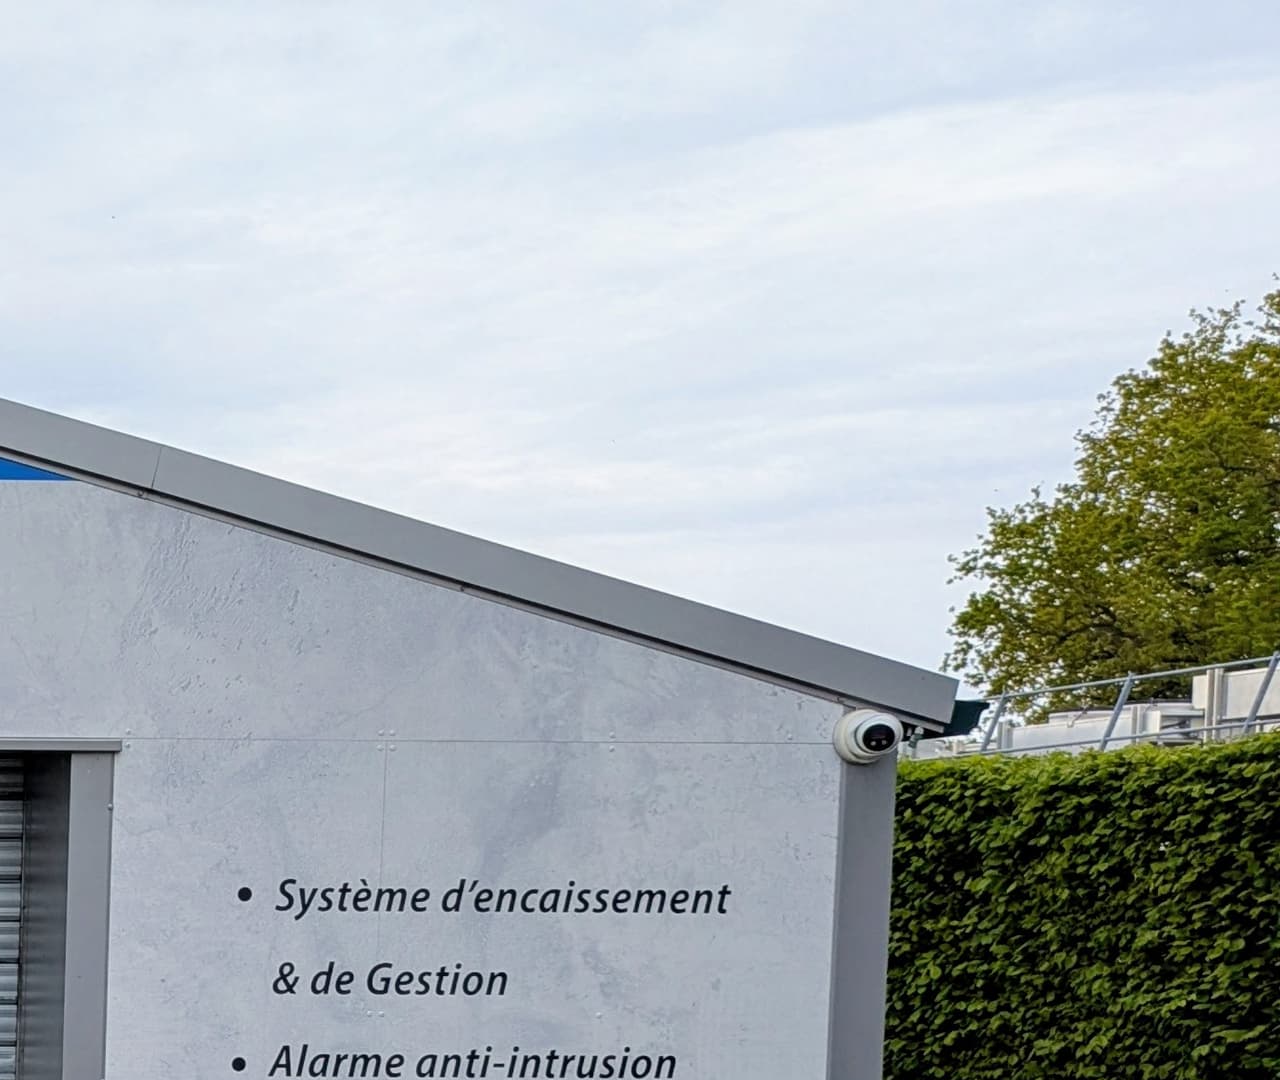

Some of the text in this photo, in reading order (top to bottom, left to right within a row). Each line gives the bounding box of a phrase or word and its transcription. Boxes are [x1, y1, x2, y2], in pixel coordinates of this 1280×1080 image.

[276, 879, 732, 920] Système d'encaissement
[273, 962, 508, 996] & de Gestion
[269, 1044, 677, 1080] Alarme anti-intrusion
